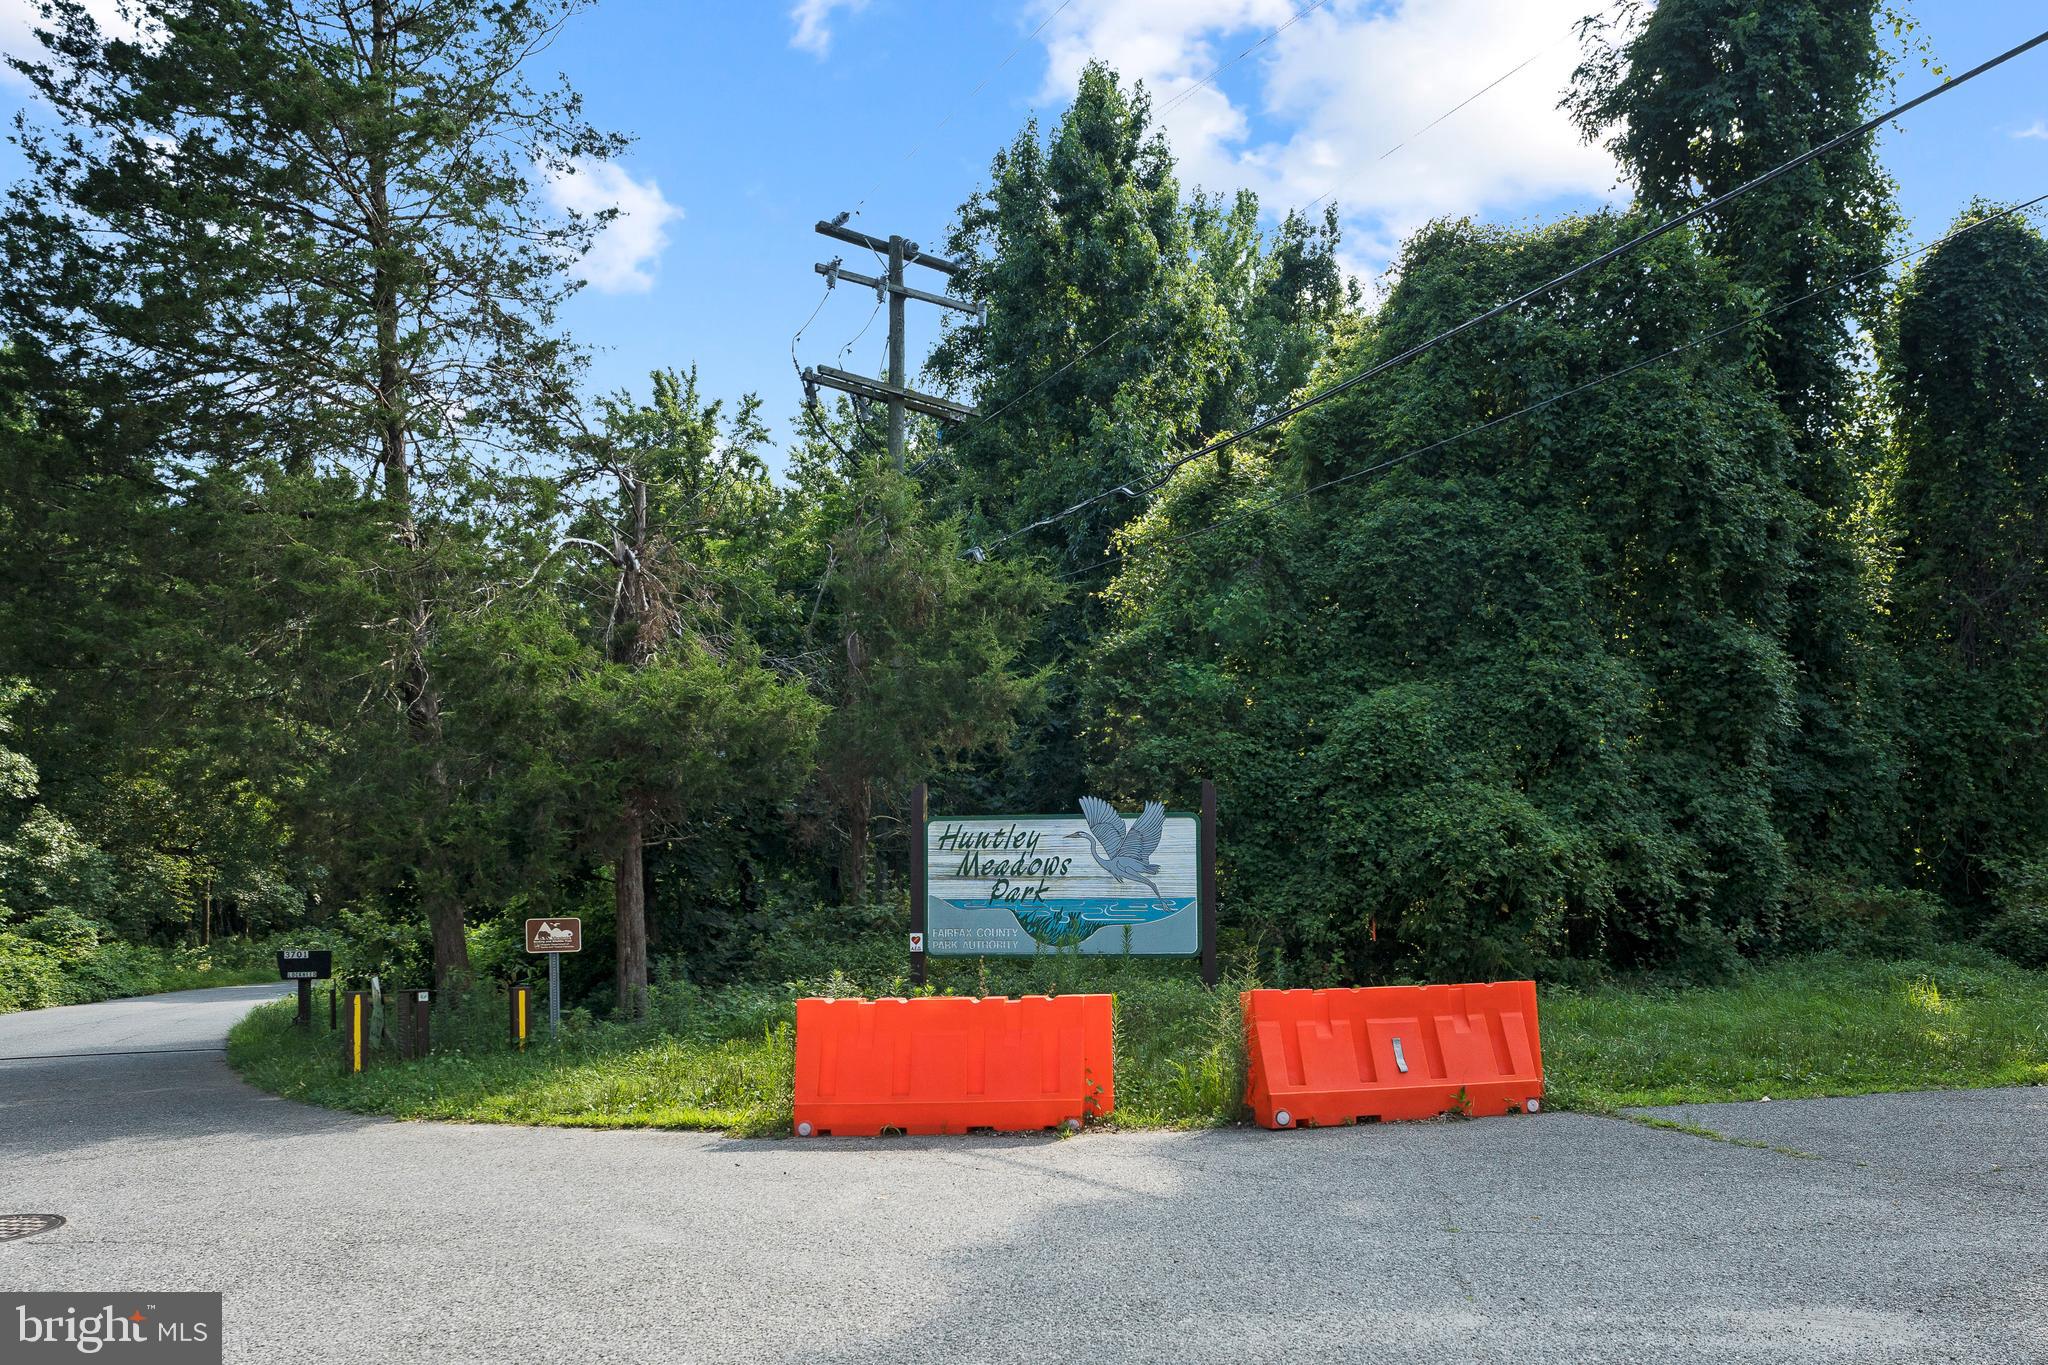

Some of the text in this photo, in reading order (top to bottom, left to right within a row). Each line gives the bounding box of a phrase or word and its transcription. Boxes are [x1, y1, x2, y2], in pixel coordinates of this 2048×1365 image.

[939, 824, 1041, 857] Huntley
[956, 850, 1072, 877] Meadows
[989, 878, 1050, 905] Park
[932, 928, 1018, 938] FAIRFAX COUNTY
[932, 940, 1018, 950] PARK AUTHORITY
[285, 951, 308, 959] 3701
